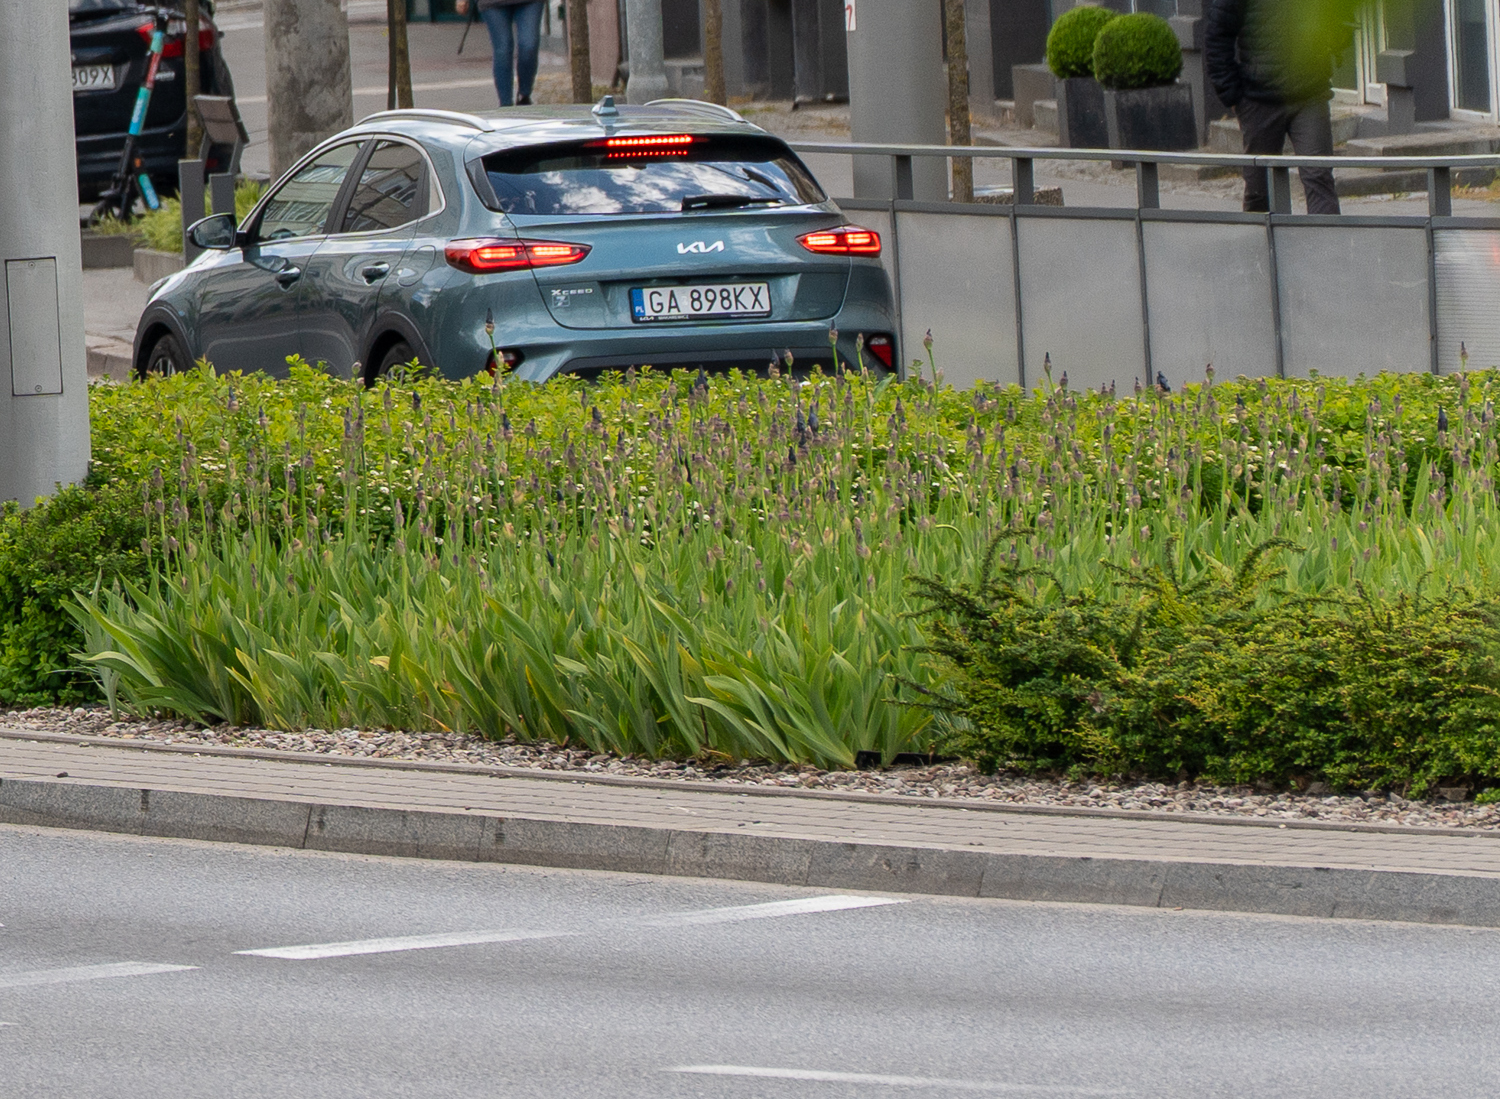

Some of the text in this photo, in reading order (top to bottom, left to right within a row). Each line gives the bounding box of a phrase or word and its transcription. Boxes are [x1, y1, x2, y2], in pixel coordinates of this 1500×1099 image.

[677, 240, 725, 254] KIA
[649, 289, 682, 314] GA
[691, 286, 765, 312] 898KX
